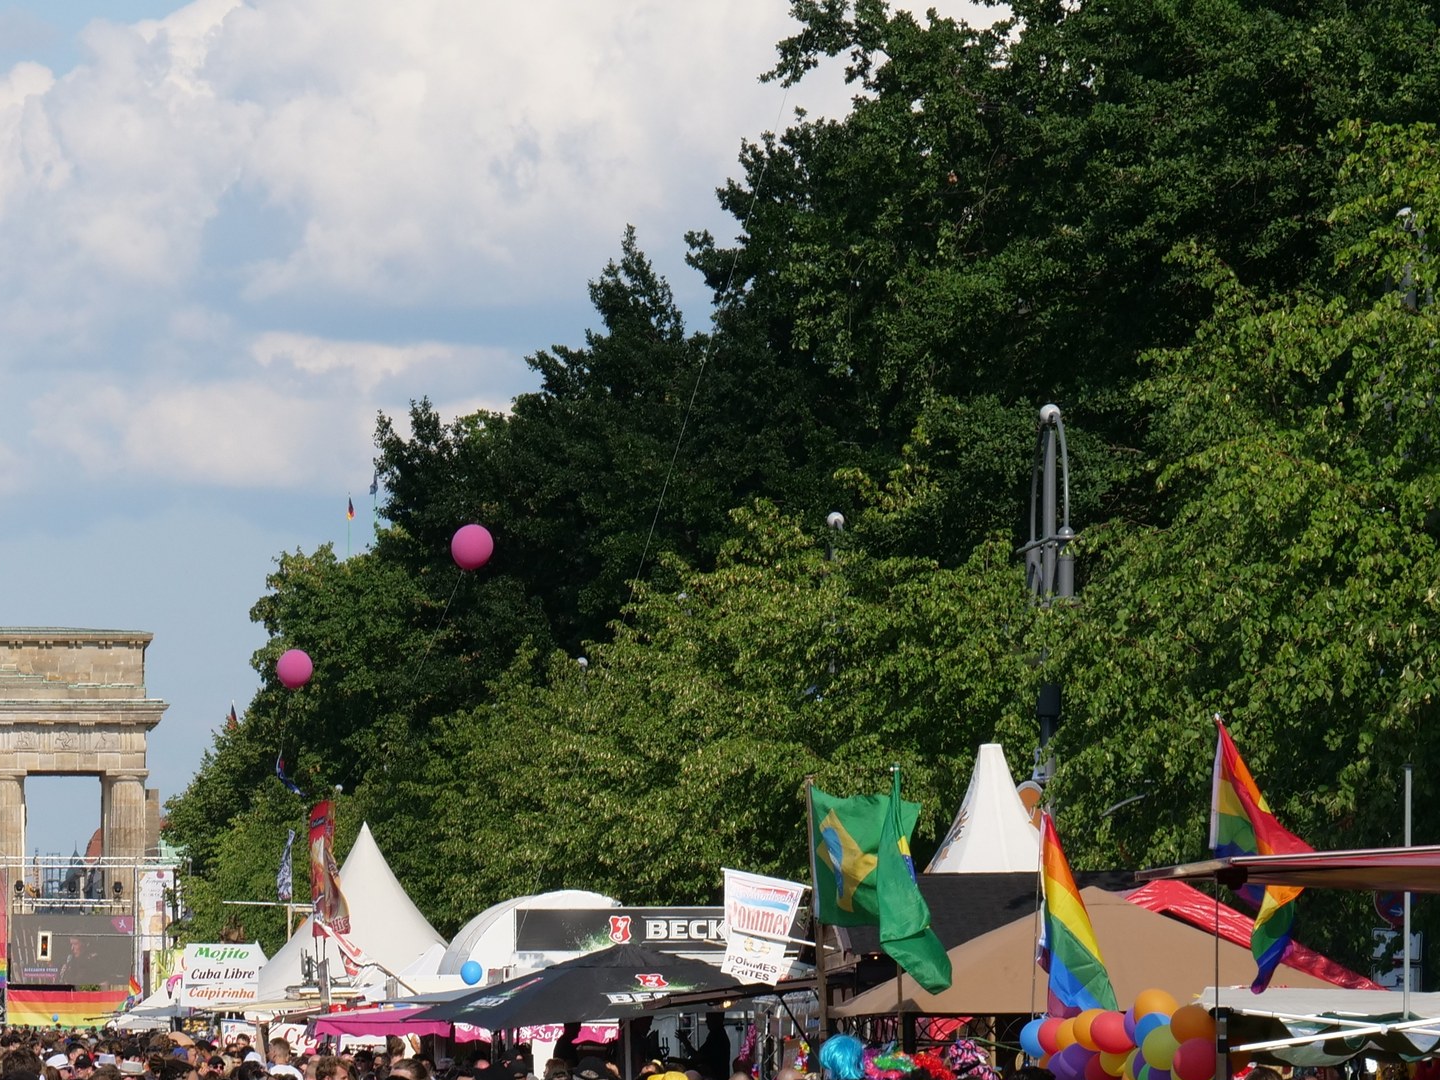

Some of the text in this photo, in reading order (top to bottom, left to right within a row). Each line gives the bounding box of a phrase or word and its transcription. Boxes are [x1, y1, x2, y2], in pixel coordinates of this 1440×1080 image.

[195, 947, 249, 961] Mojito
[728, 955, 777, 973] POMMES
[191, 968, 255, 979] Cuba Libre
[189, 987, 255, 1000] Caipirinha
